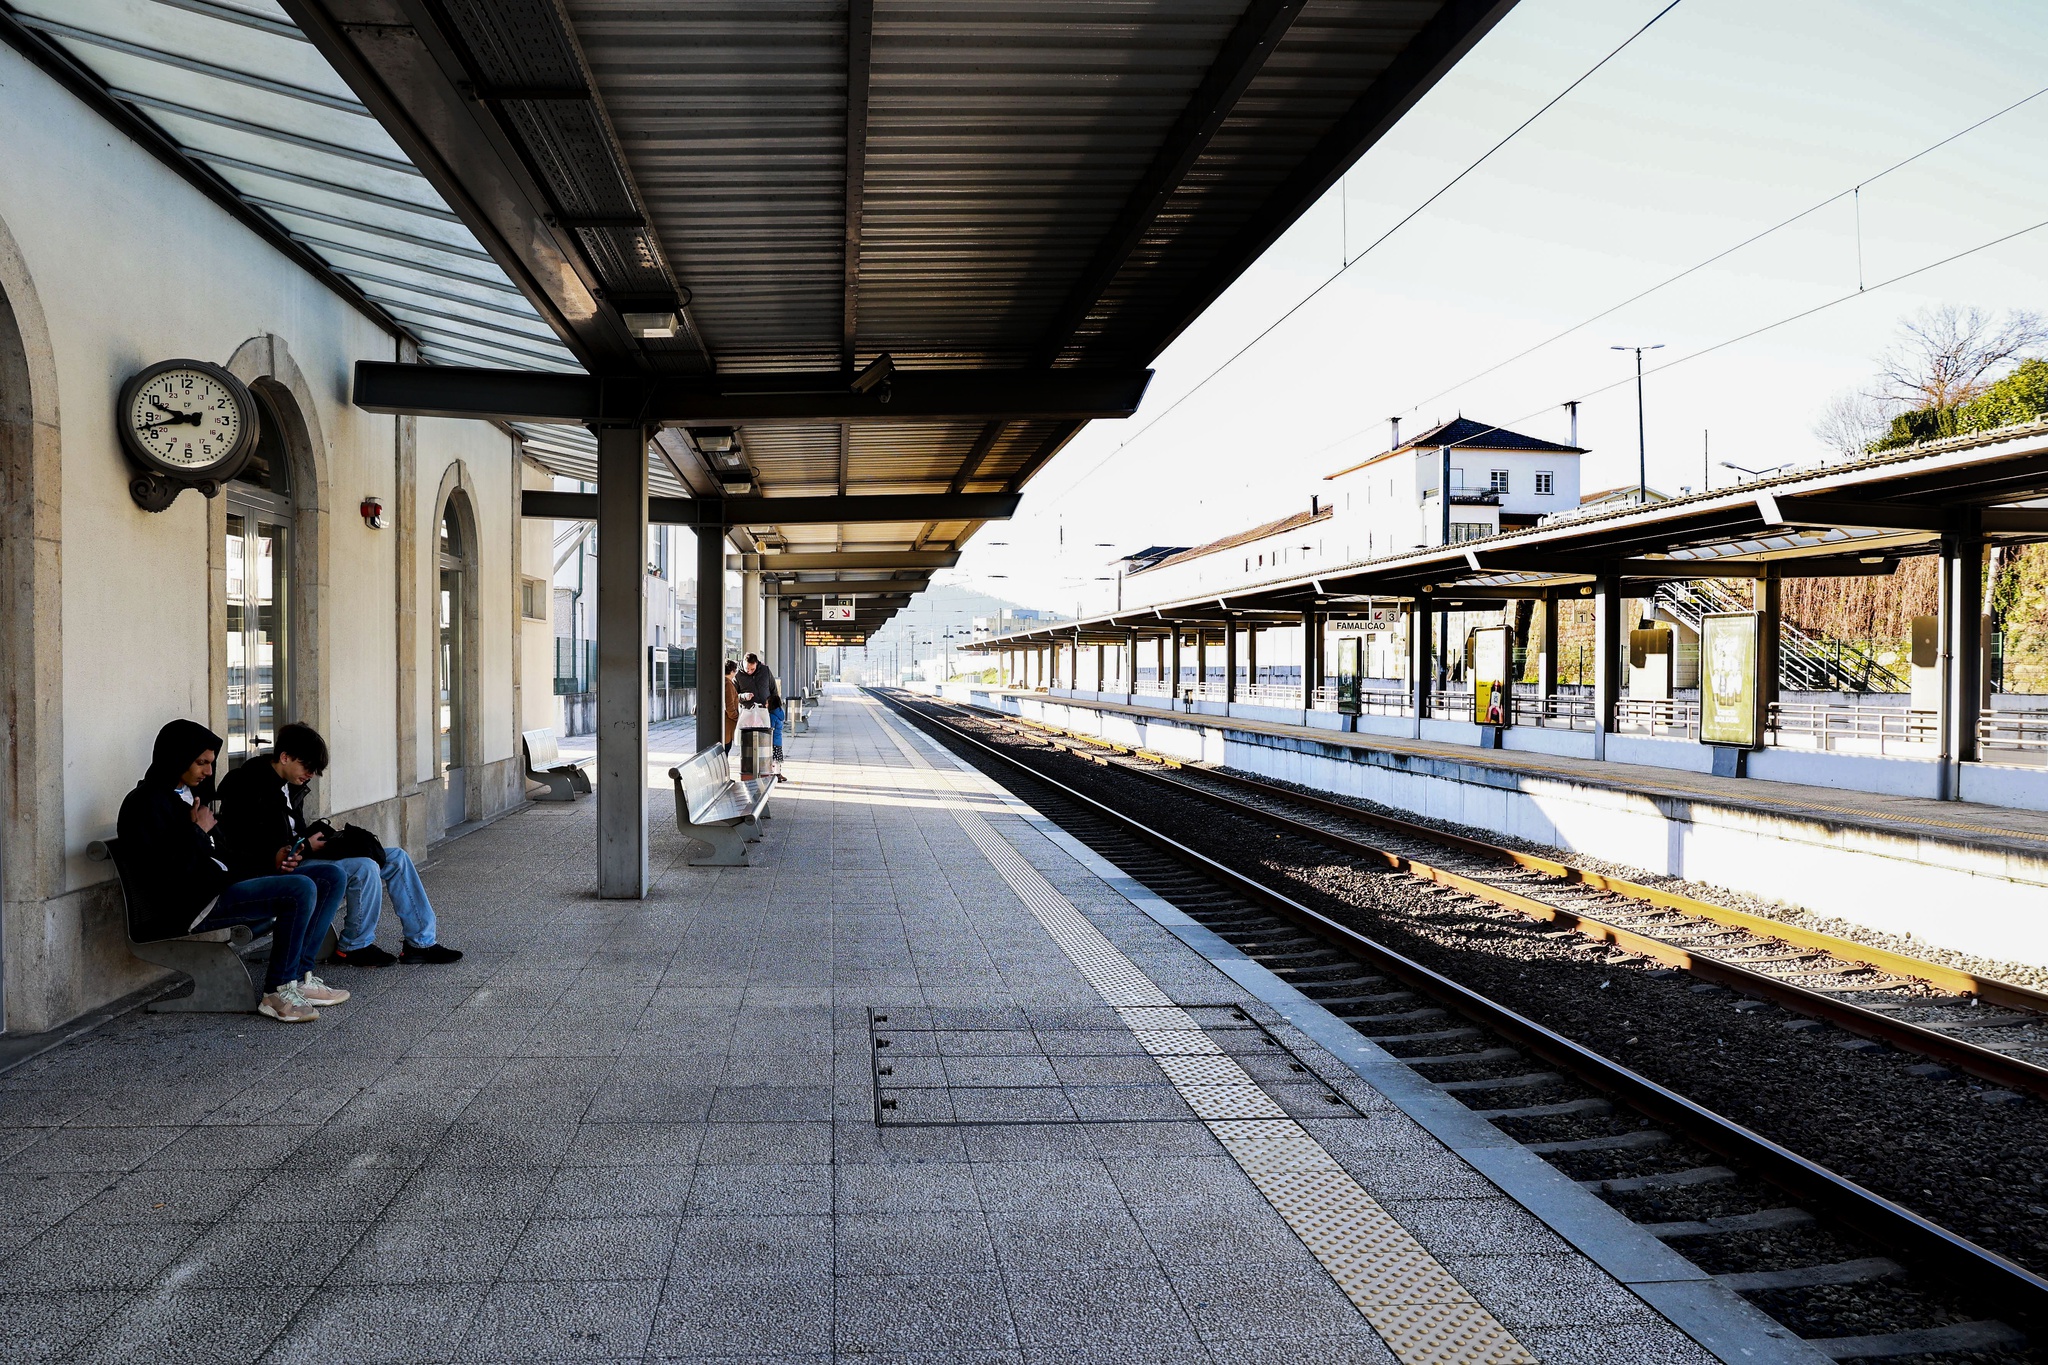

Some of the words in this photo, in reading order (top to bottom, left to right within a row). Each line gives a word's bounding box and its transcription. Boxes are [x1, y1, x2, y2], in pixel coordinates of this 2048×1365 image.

[165, 383, 172, 392] 11
[181, 379, 193, 389] 12
[206, 386, 209, 395] 1
[148, 395, 160, 404] 10
[217, 399, 225, 409] 2
[146, 412, 154, 422] 9
[222, 416, 230, 426] 3
[150, 429, 159, 439] 8
[216, 433, 224, 442] 4
[166, 443, 174, 452] 7
[203, 444, 211, 454] 5
[185, 448, 193, 458] 6
[828, 610, 835, 618] 2
[1389, 613, 1394, 622] 3
